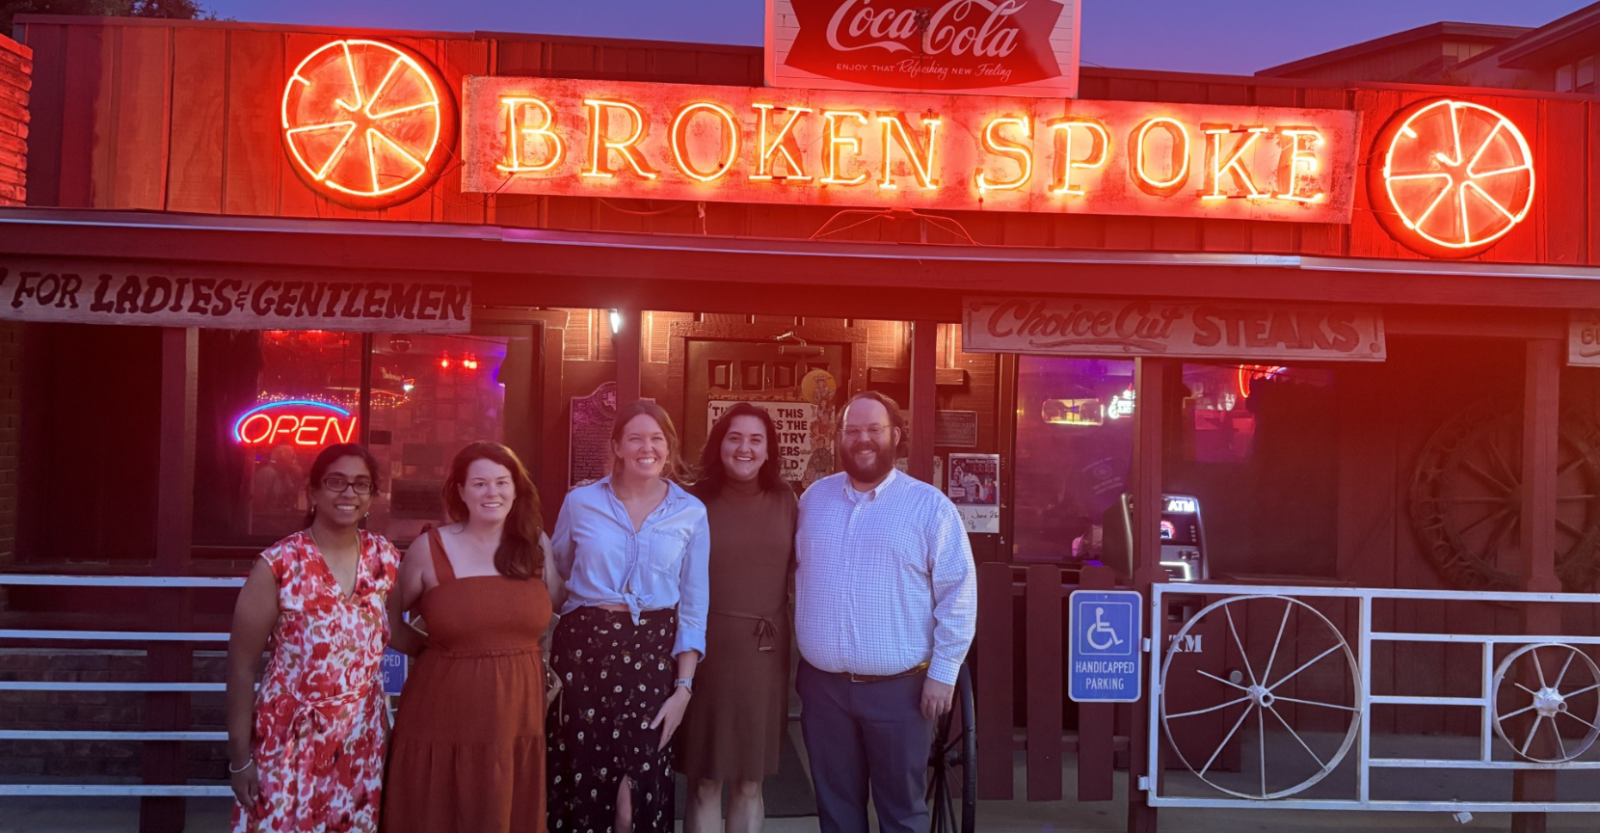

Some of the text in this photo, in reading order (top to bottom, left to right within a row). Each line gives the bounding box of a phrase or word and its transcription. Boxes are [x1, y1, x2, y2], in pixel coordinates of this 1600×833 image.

[836, 63, 867, 71] ENJOY
[872, 64, 895, 73] THAT
[951, 67, 972, 76] NEW
[974, 64, 1012, 82] Feeling
[496, 96, 1325, 203] BROKEN SPOKE
[11, 271, 83, 309] FOR
[90, 274, 243, 317] LADIES
[250, 279, 471, 321] GENTLEMEN
[987, 301, 1114, 338] Choice
[1114, 301, 1184, 340] Cut
[777, 408, 804, 418] THIS
[241, 413, 357, 445] OPEN
[786, 420, 808, 431] THE
[1167, 499, 1195, 513] ATM
[1075, 661, 1135, 674] HANDICAPPED
[1085, 677, 1125, 690] PARKING
